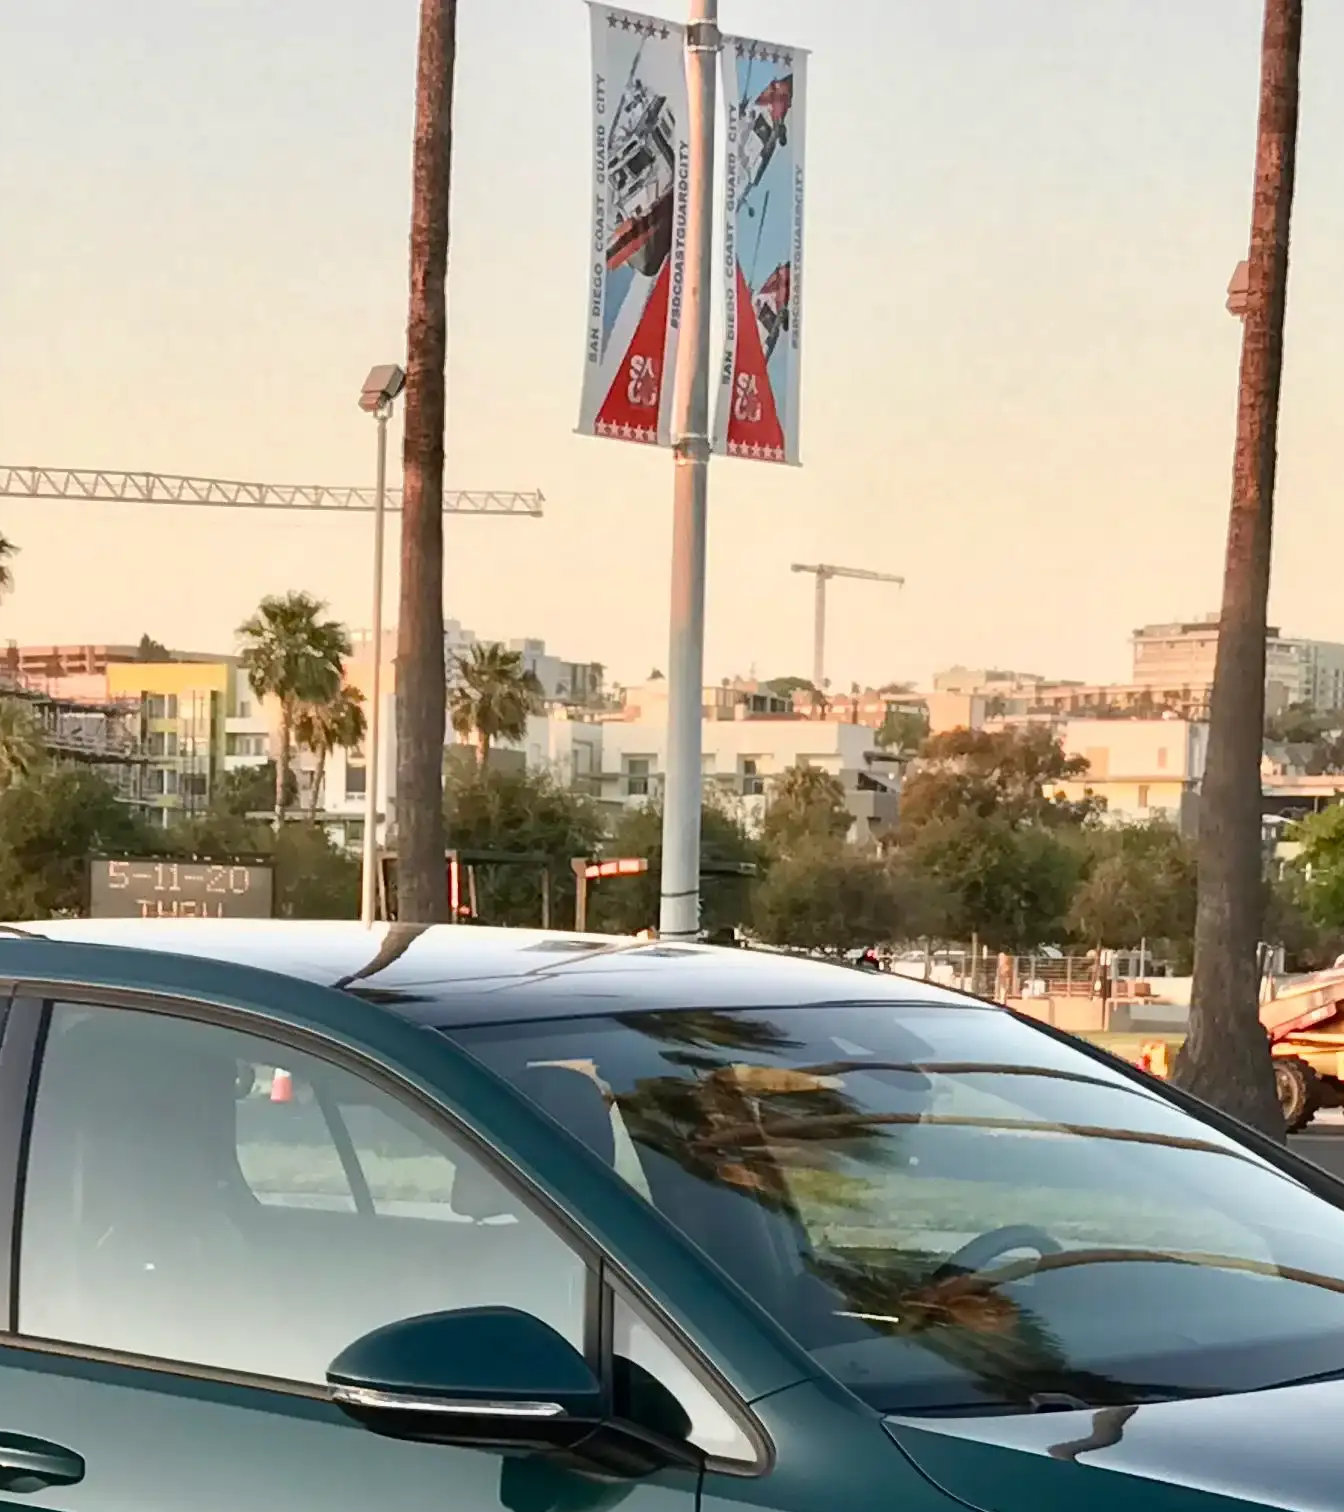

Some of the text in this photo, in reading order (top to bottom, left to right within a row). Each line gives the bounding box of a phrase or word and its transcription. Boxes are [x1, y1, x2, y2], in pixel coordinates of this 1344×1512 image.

[588, 73, 607, 364] SAN DIEGO COAST GUARD CITY
[670, 139, 690, 329] #SDCOASTGUARDCITY
[721, 102, 738, 385] SAN DIEGO COAST GUARD CITY
[109, 861, 250, 893] 5-11-20
